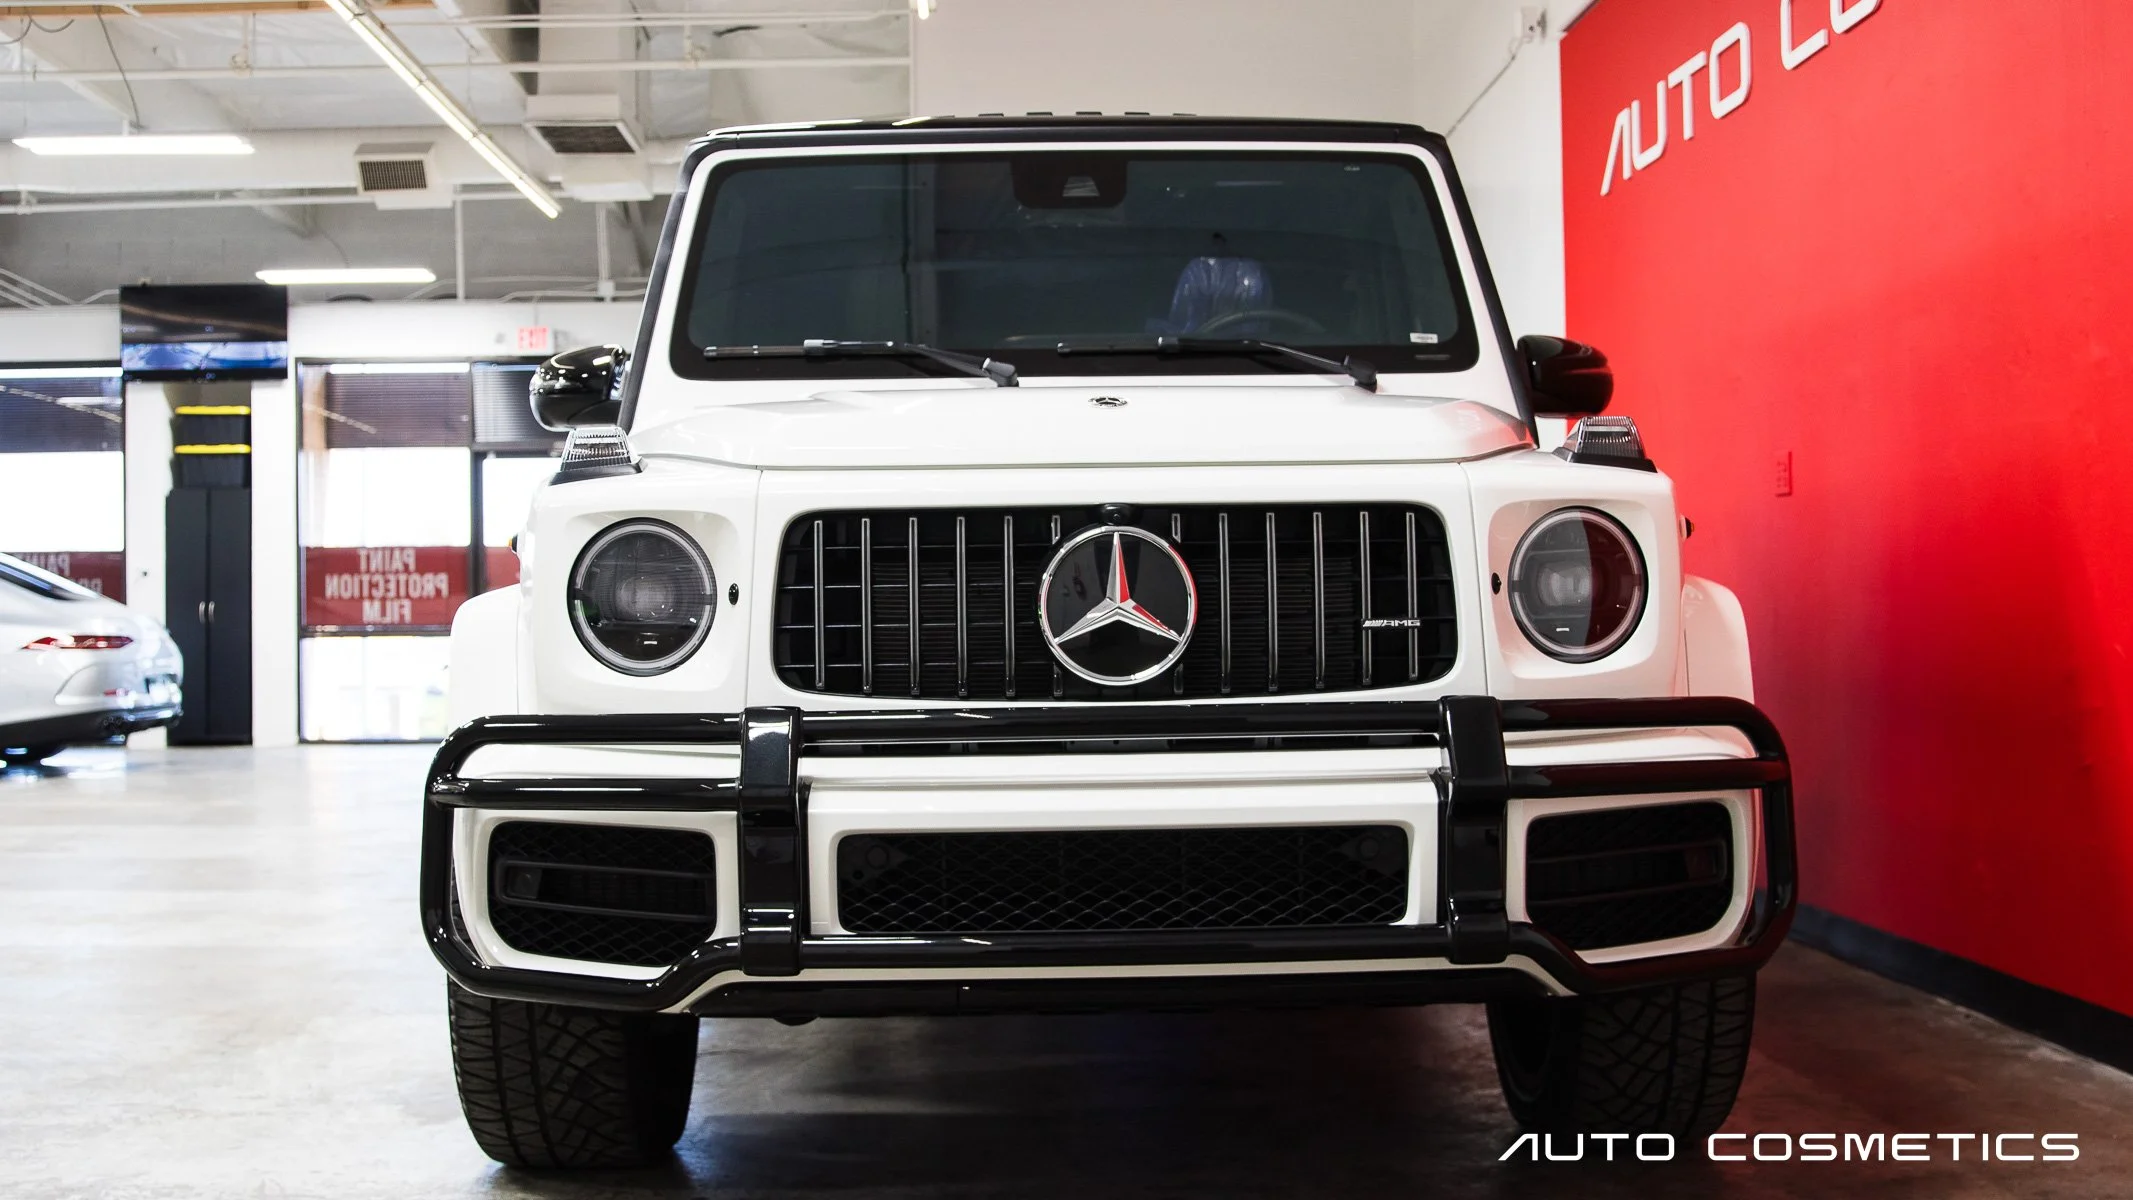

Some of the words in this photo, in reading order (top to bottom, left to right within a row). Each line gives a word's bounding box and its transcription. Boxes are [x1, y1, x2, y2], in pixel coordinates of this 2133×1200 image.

[1600, 21, 1752, 196] AUTO
[518, 327, 549, 351] EXIT
[1378, 619, 1421, 627] AMG
